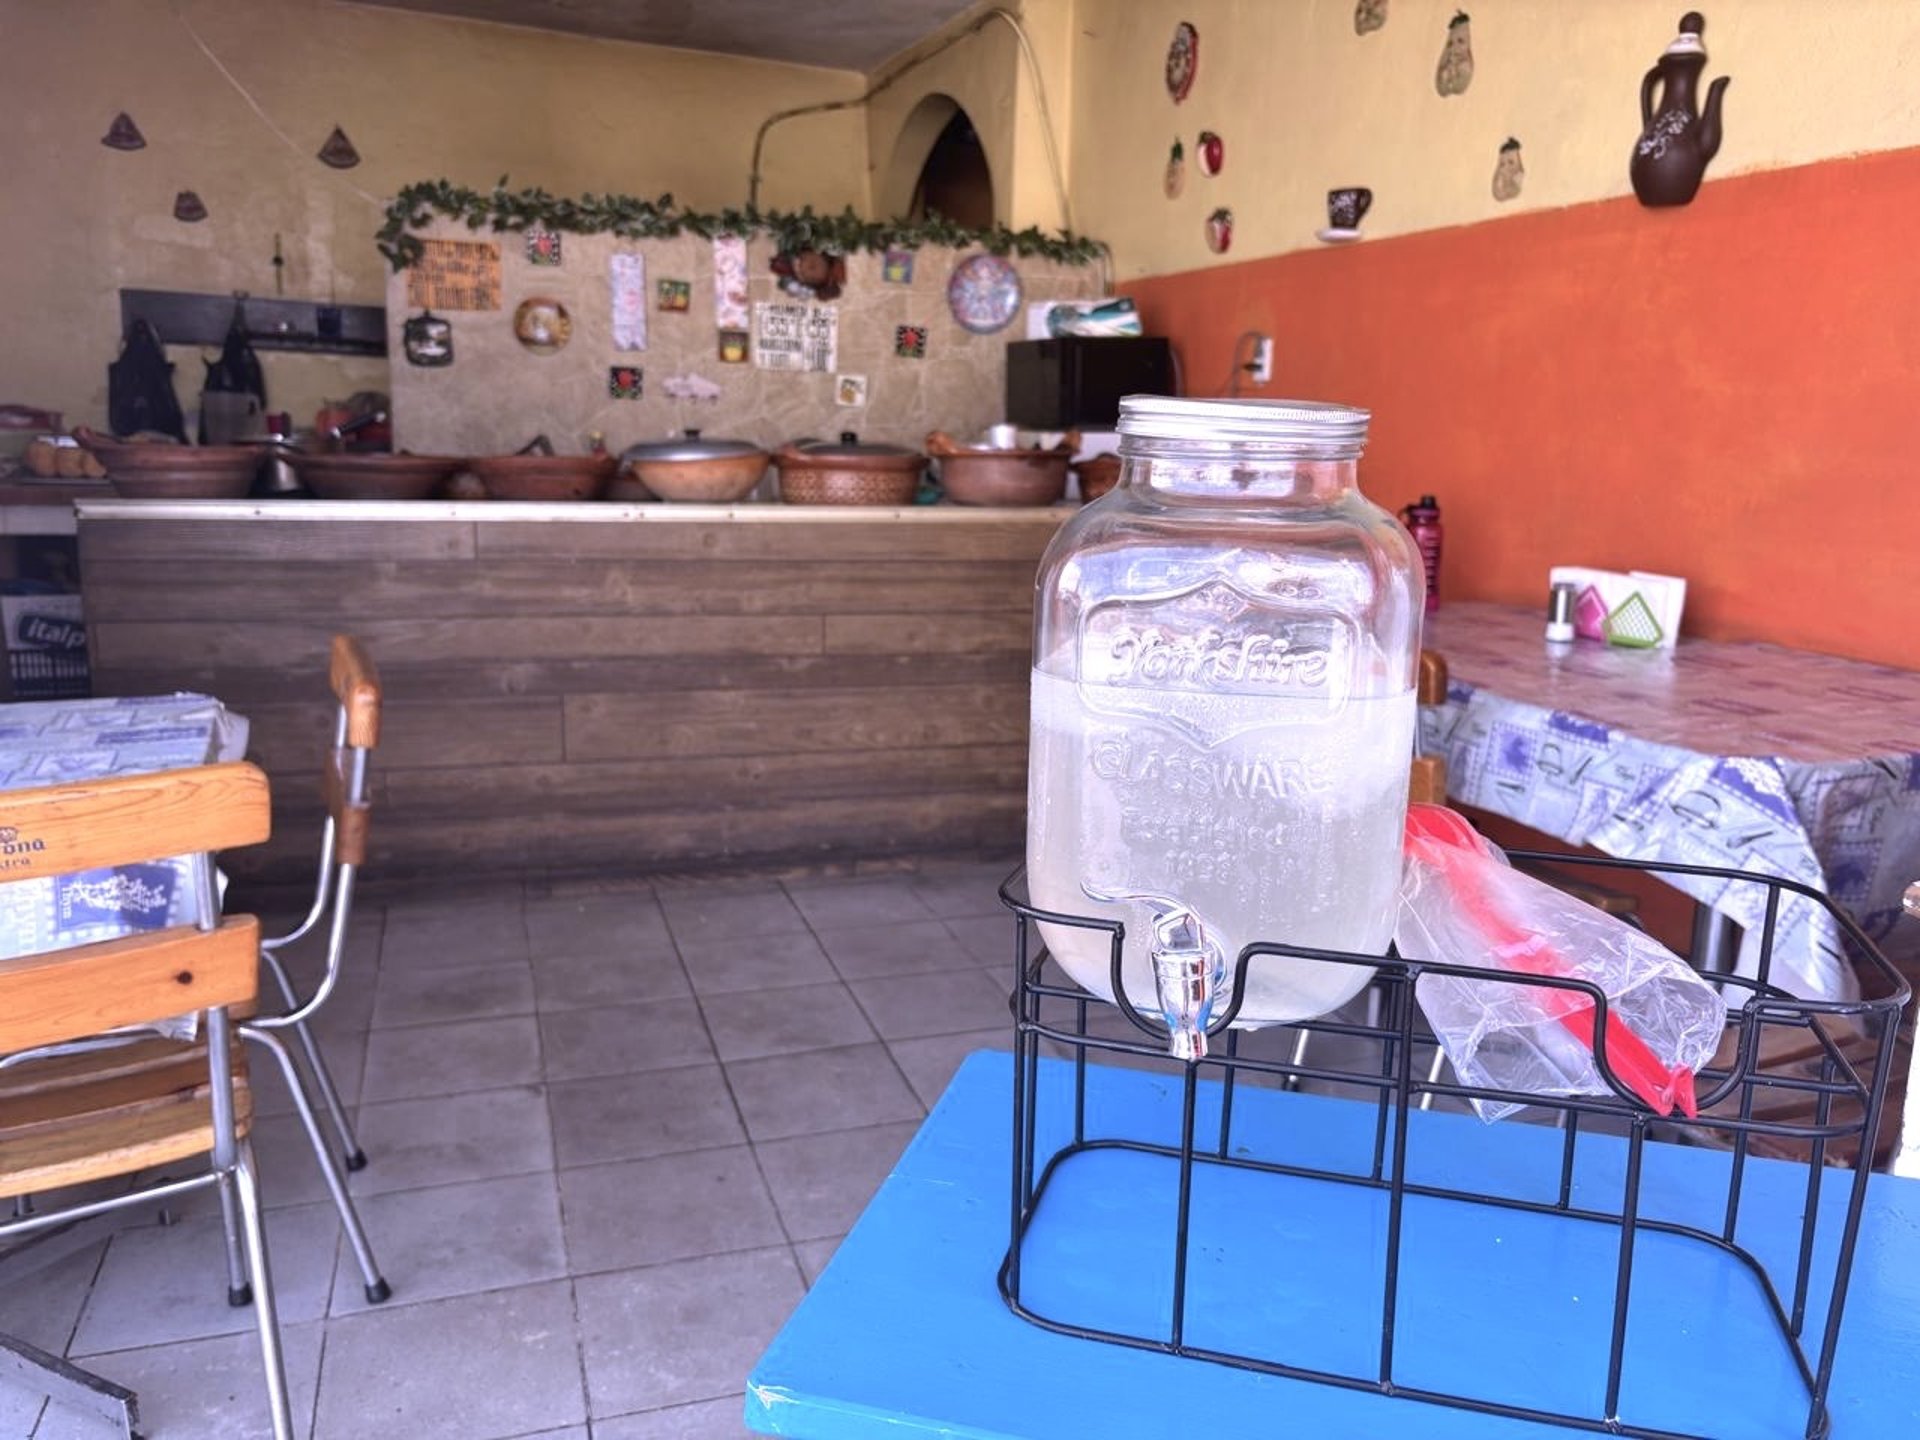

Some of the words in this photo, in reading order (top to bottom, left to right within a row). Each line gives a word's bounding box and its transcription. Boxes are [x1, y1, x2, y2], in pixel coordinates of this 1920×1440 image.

[27, 617, 86, 650] italp
[1108, 627, 1329, 687] Yorkshire
[0, 838, 46, 855] ona
